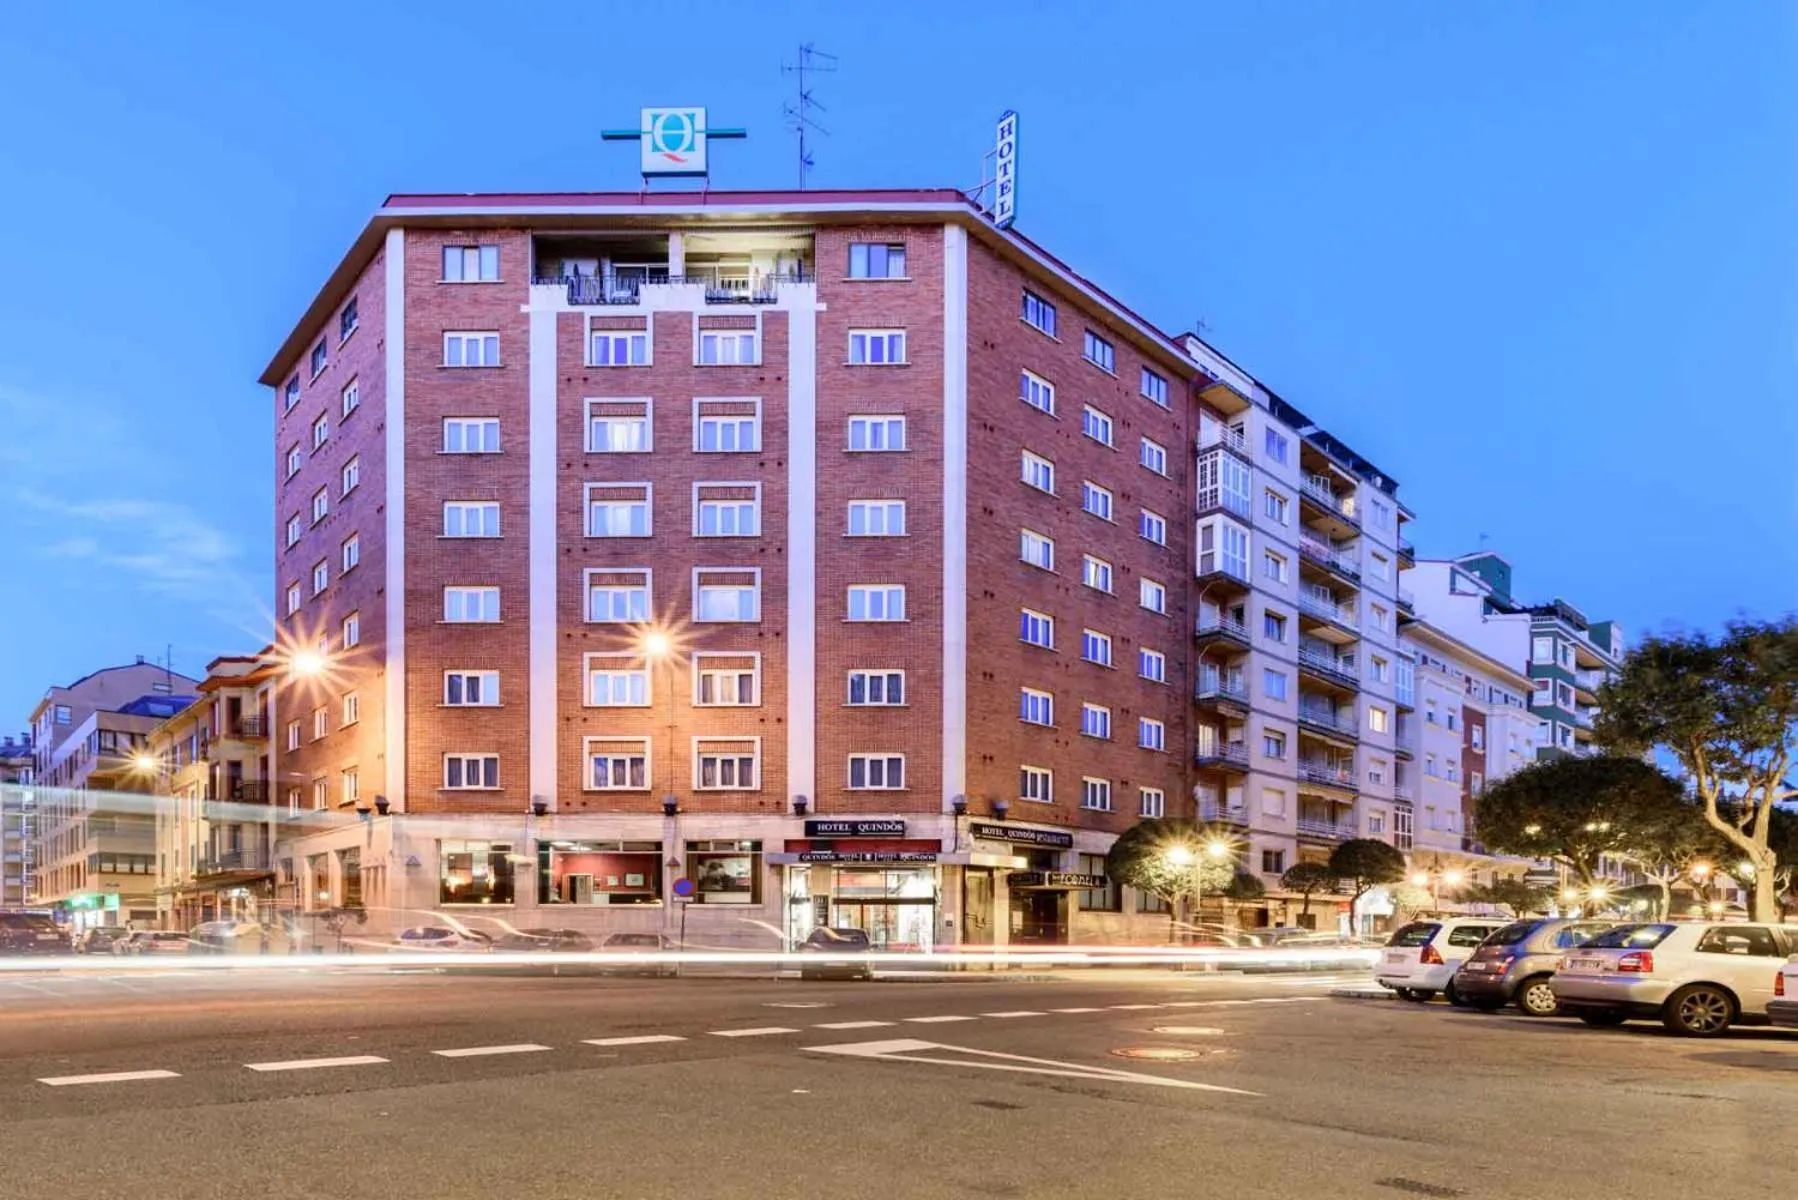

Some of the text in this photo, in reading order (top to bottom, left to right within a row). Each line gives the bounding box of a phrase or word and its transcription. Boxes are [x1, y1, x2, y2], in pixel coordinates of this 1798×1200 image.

[999, 120, 1013, 217] HOTEL
[817, 823, 851, 832] HOTEL
[982, 825, 1004, 836] HOTEL
